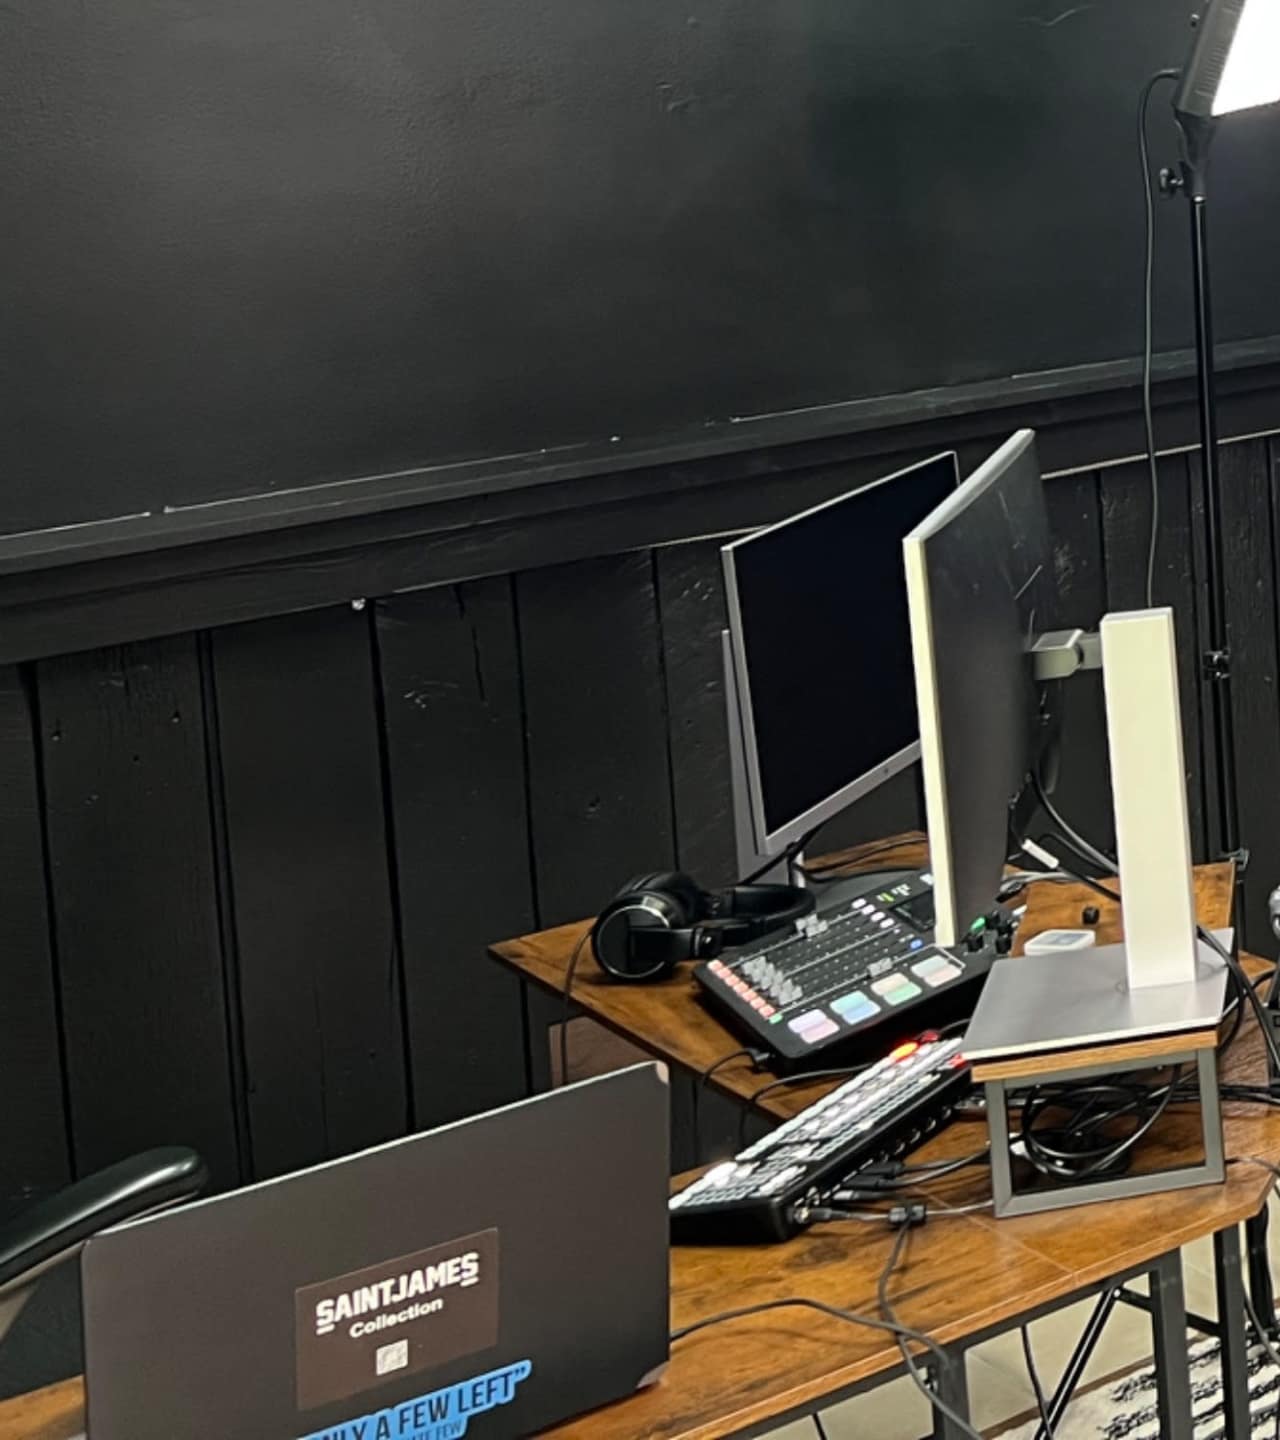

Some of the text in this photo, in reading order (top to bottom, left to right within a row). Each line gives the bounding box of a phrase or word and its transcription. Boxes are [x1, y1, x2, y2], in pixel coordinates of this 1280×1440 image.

[349, 1298, 444, 1339] Collection
[376, 1415, 391, 1439] A
[400, 1394, 449, 1435] FEW
